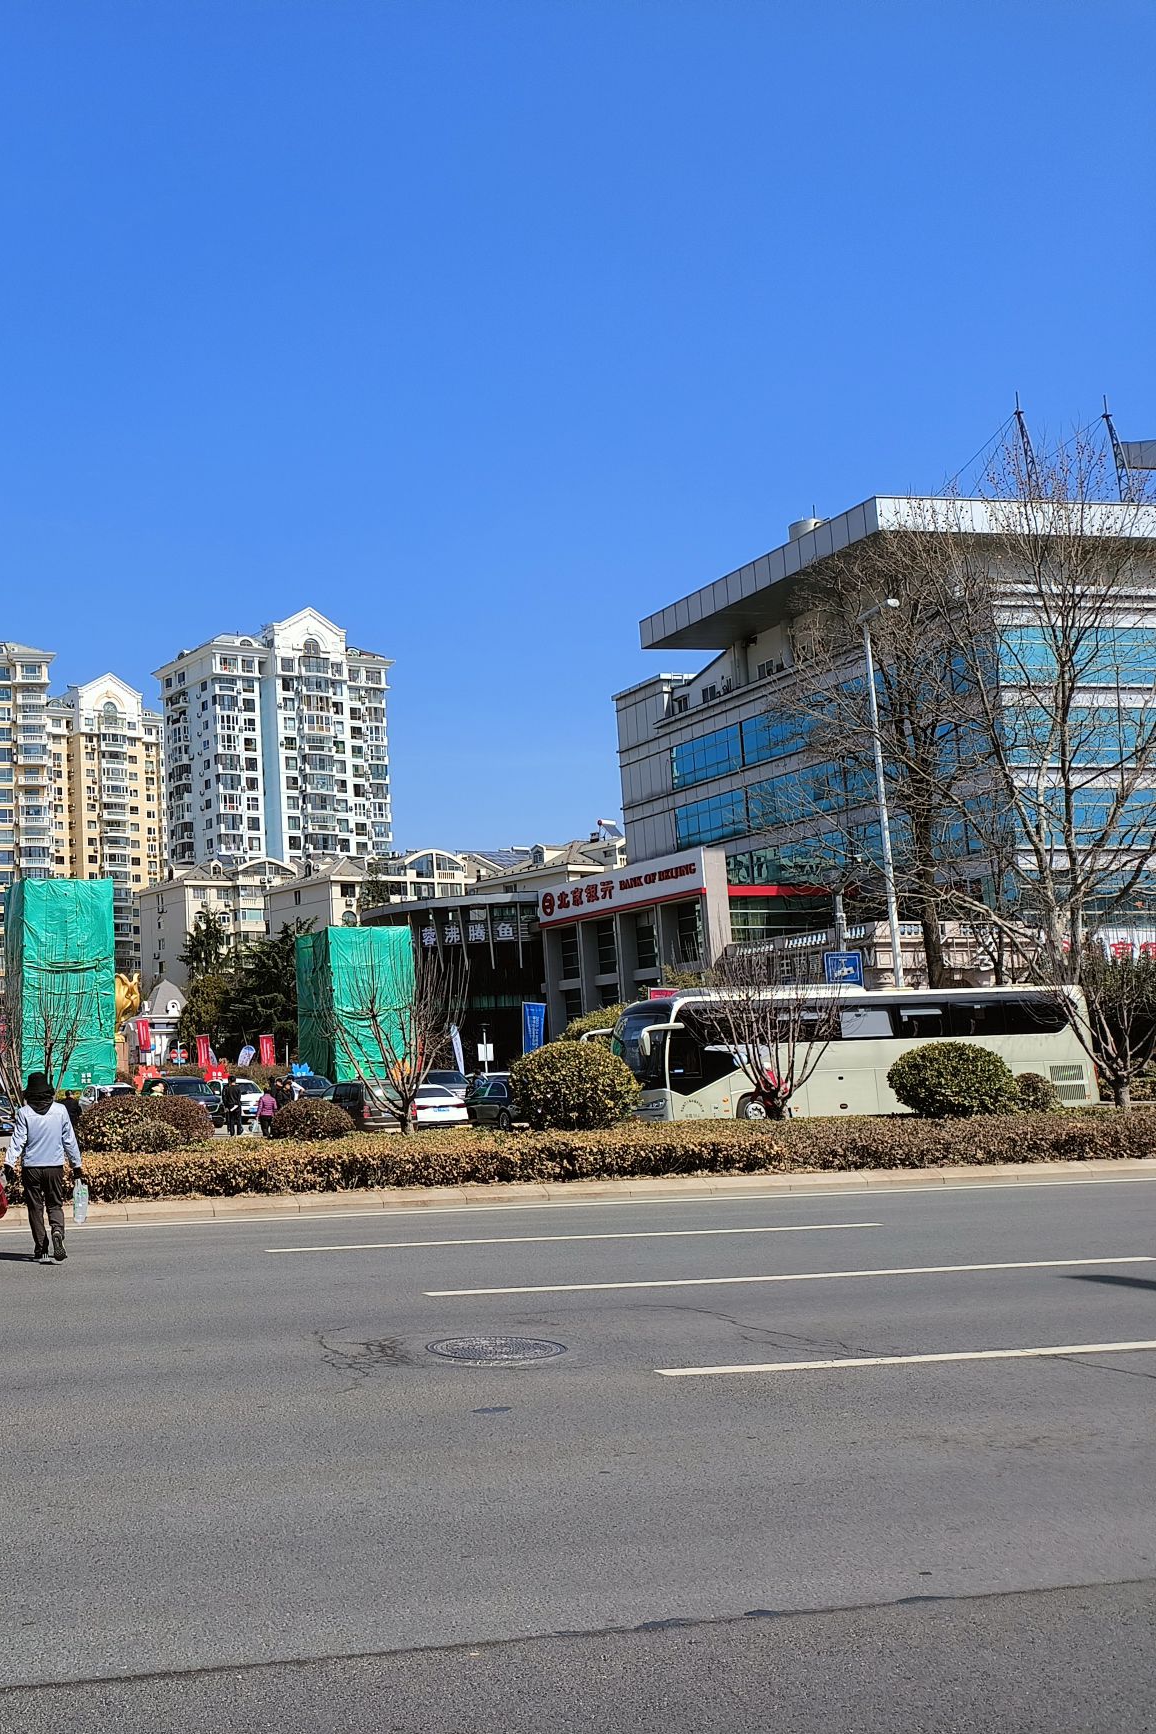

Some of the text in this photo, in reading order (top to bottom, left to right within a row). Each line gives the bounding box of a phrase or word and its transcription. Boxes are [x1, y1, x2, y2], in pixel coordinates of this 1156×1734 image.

[619, 862, 696, 891] BANK OF BEIJING
[557, 880, 614, 909] 北京银行
[412, 922, 515, 946] 蓉沸腾鱼
